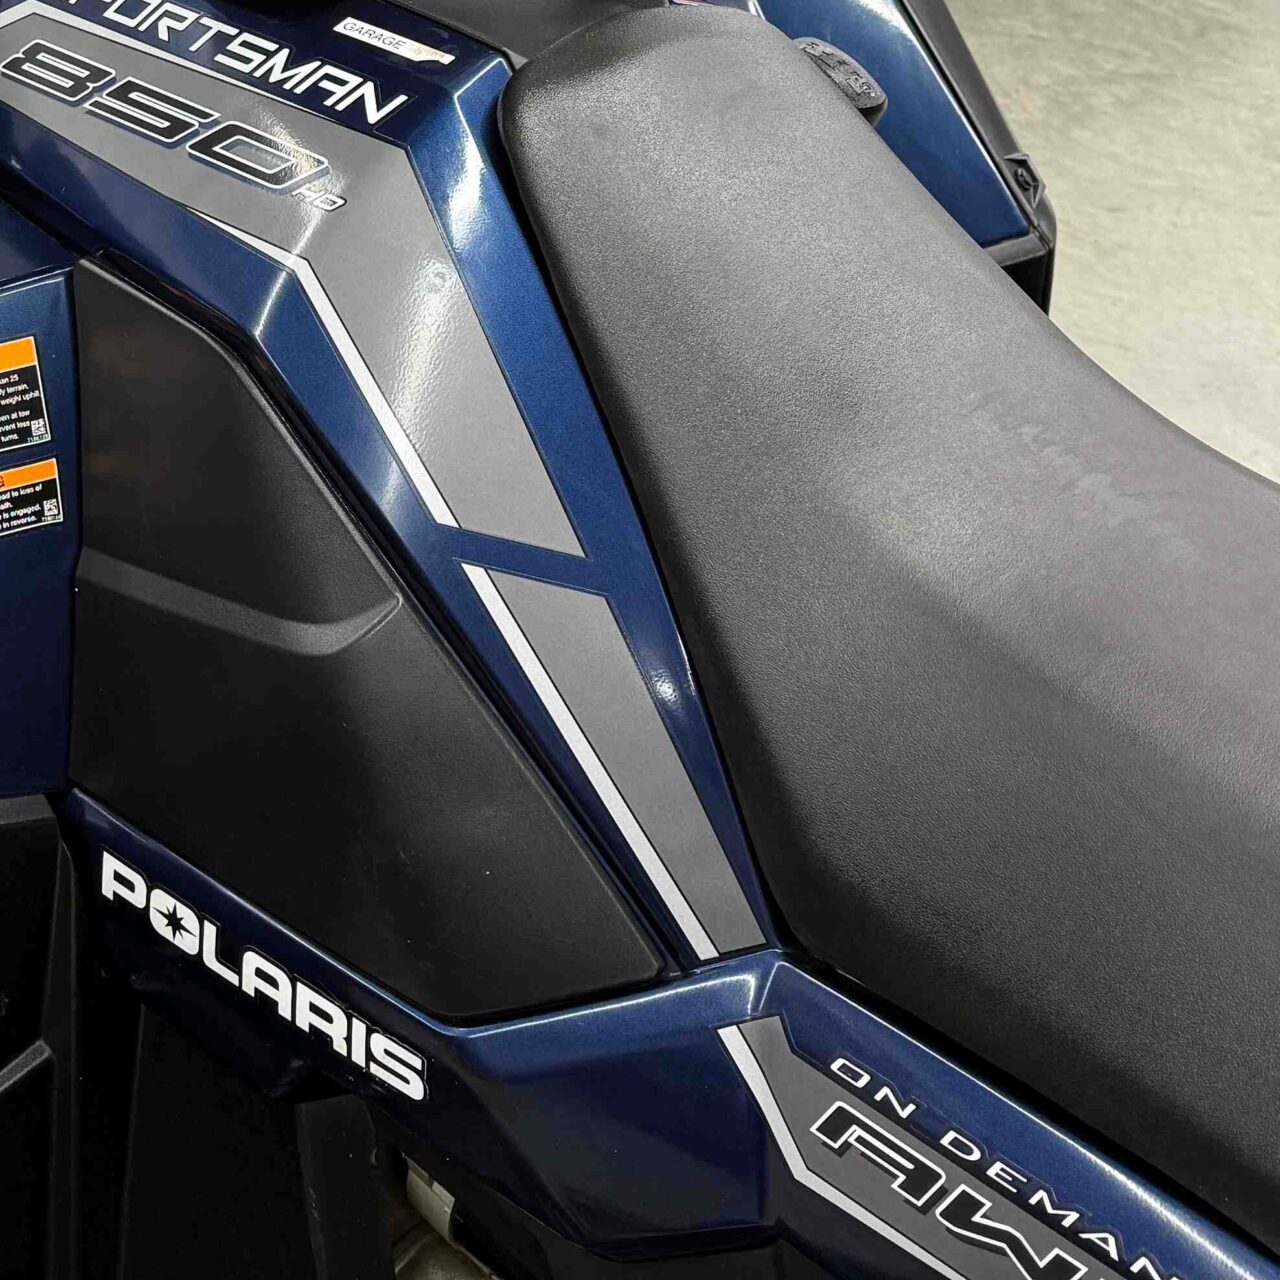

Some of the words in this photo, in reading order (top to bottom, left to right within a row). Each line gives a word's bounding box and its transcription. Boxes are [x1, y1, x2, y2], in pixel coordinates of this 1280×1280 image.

[343, 22, 406, 49] GARAGE
[0, 38, 329, 190] 850
[101, 850, 424, 1101] POLARIS
[830, 1057, 917, 1120] ON
